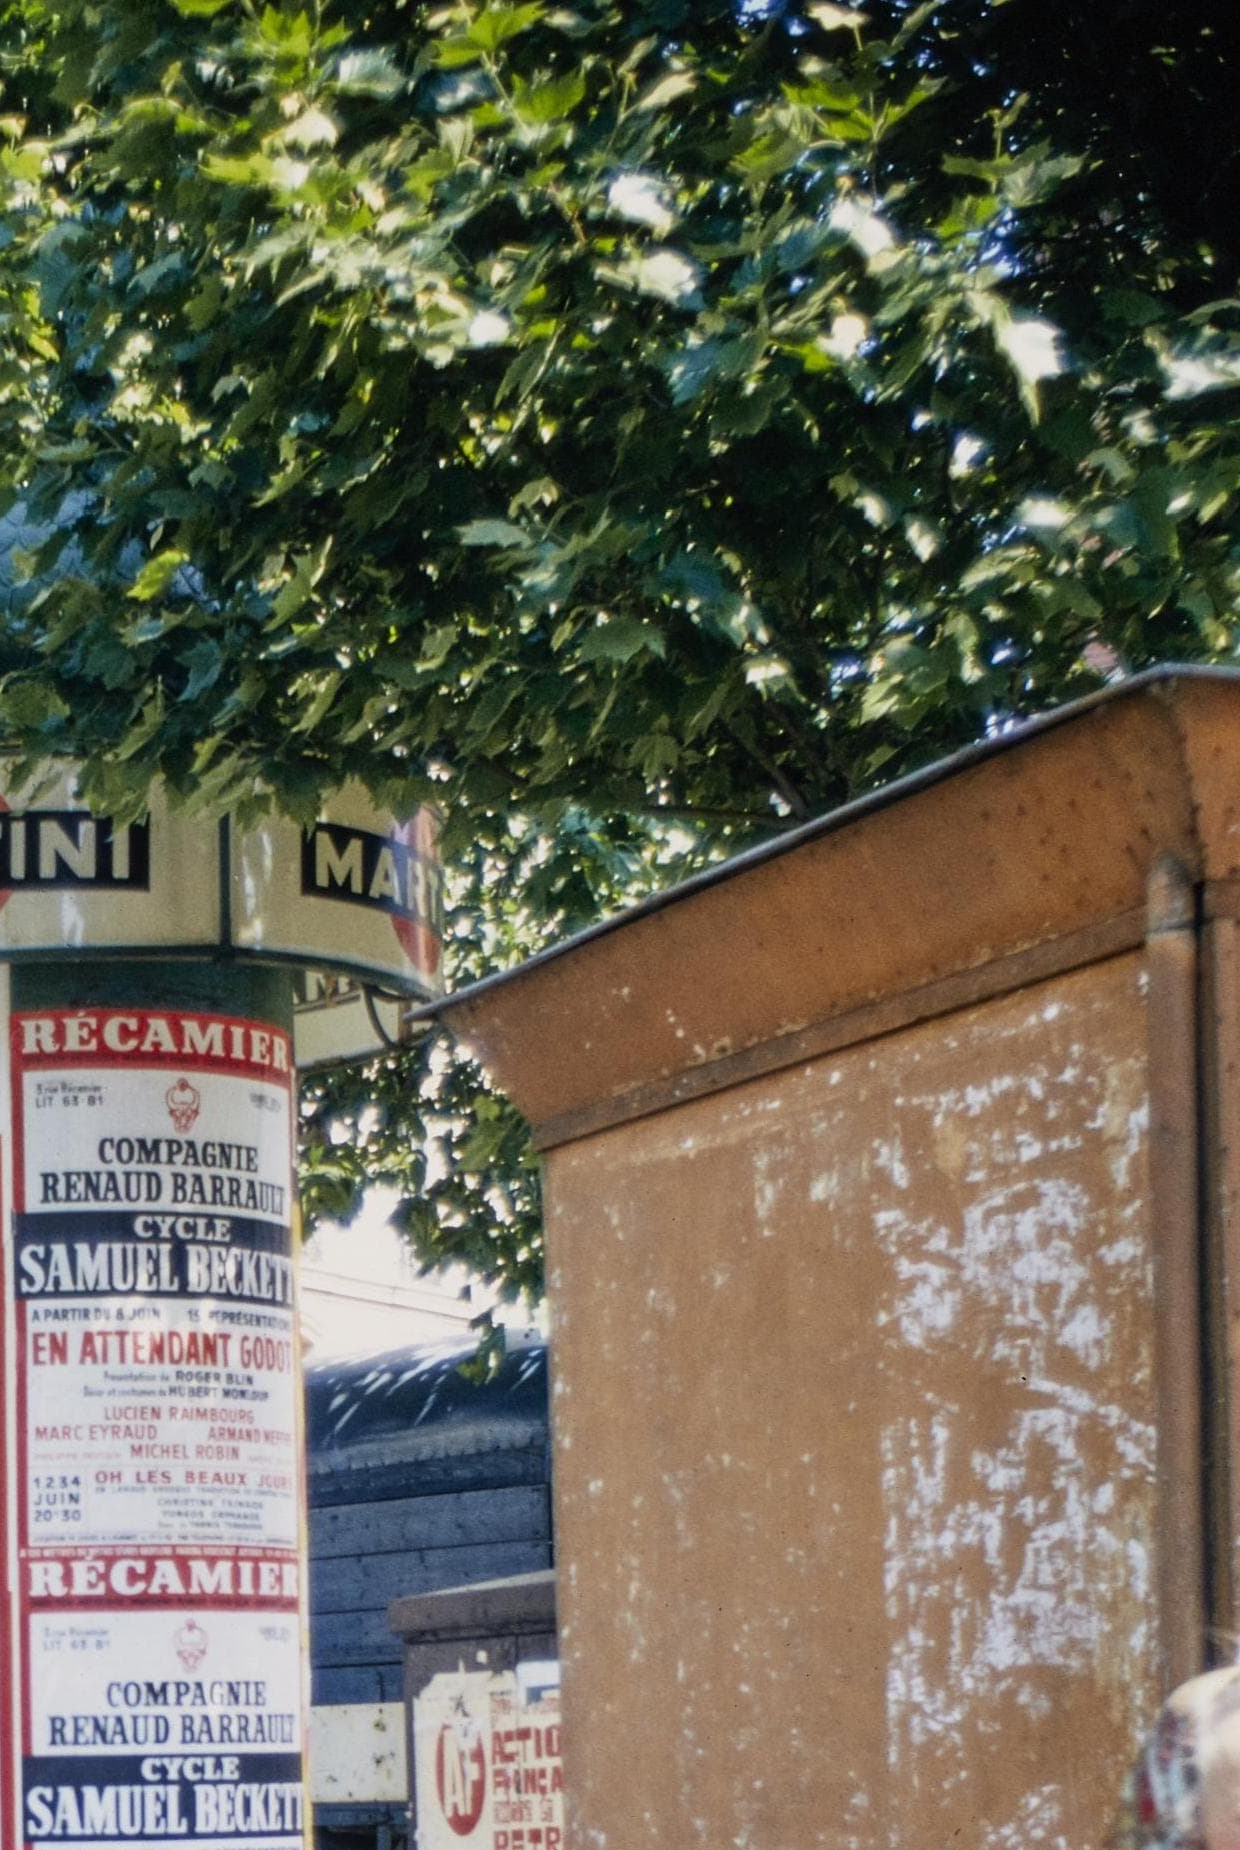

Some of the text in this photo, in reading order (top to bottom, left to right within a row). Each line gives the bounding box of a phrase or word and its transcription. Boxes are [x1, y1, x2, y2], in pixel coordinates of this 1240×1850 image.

[20, 1011, 288, 1072] RÉCAMIER
[98, 1137, 258, 1172] COMPAGNIE
[40, 1171, 285, 1217] RENAUD BARRAULT
[133, 1215, 232, 1243] CYCLE
[20, 1243, 292, 1304] SAMUEL BECKETT
[44, 1308, 90, 1321] PARTIR
[32, 1330, 291, 1374] EN ATTENDANT GODOT
[176, 1371, 221, 1384] ROGER
[225, 1372, 254, 1386] BLIN
[168, 1386, 217, 1399] HUBERT
[104, 1406, 254, 1424] LUCIEN RAIMBOURG
[34, 1424, 259, 1443] MARC EYRAUD ARMAND
[130, 1444, 189, 1459] MICHEL
[196, 1445, 240, 1460] ROBIN
[95, 1471, 121, 1484] OH
[136, 1470, 172, 1484] LES
[185, 1471, 247, 1486] BEAUX
[34, 1493, 80, 1506] JUIN
[107, 1681, 266, 1707] COMPAGNIE
[48, 1714, 295, 1746] RENAUD BARRAULT
[141, 1756, 240, 1781] CYCLE
[26, 1782, 303, 1836] SAMUEL BECKETT
